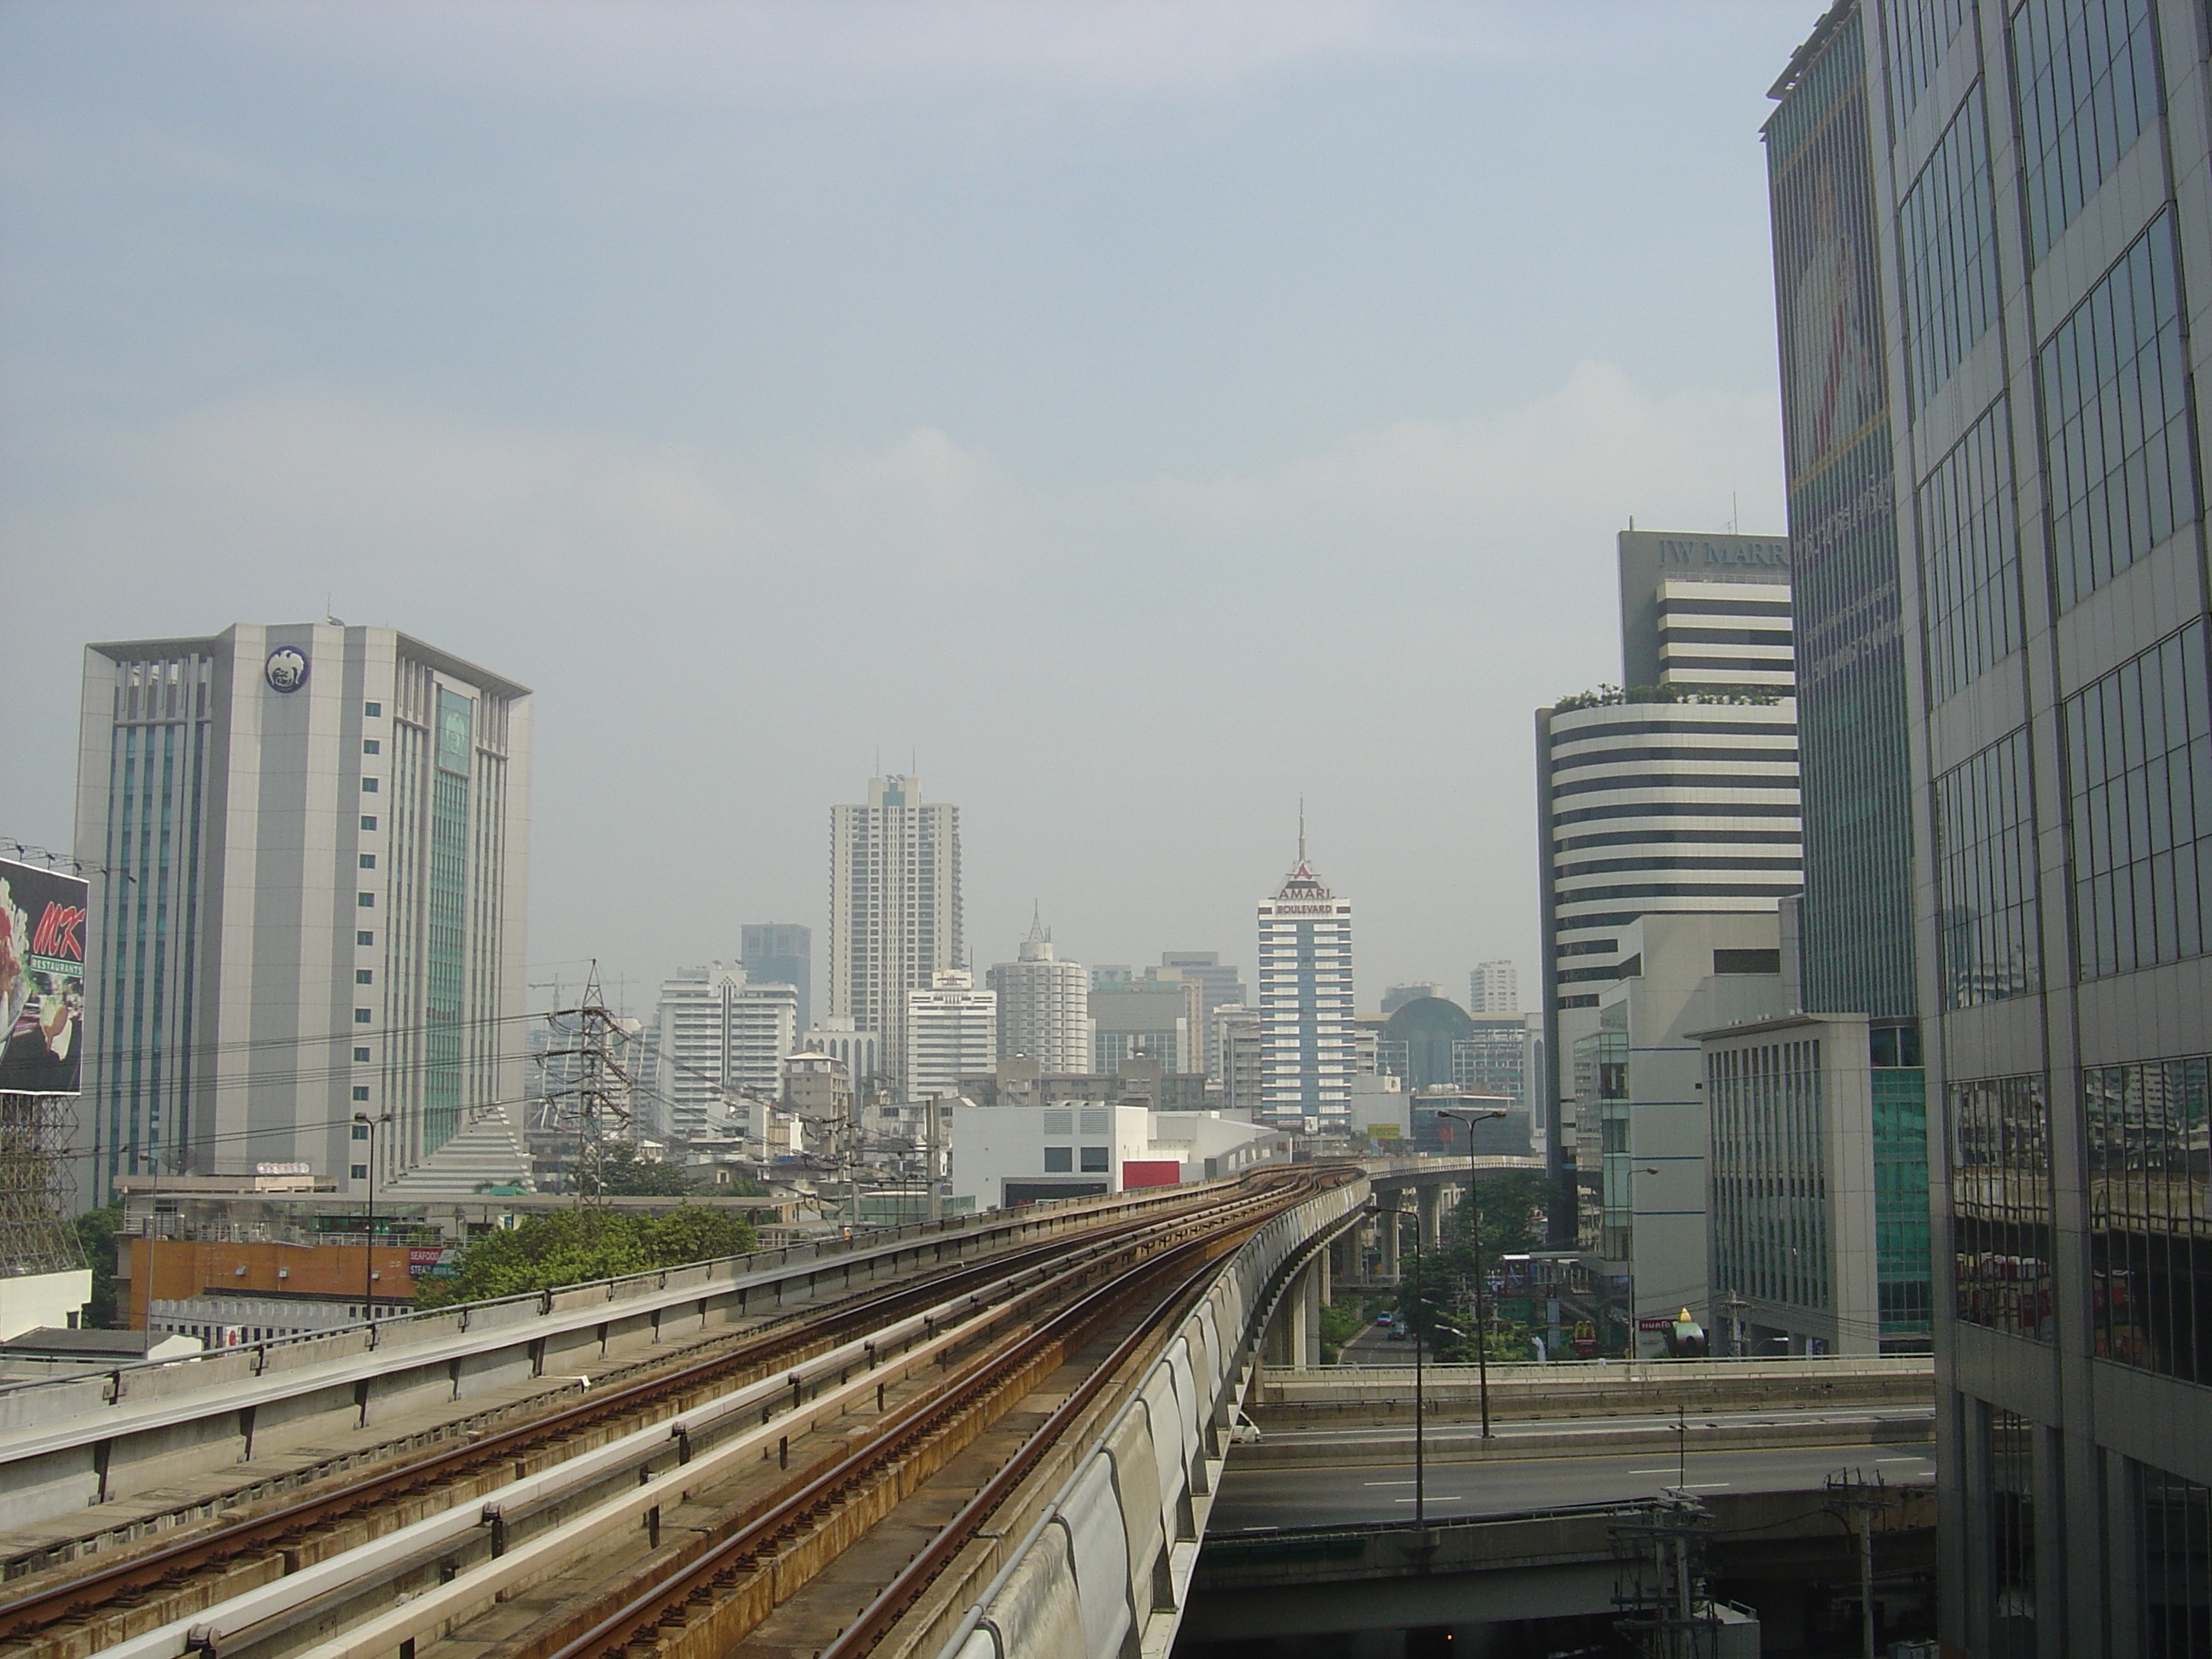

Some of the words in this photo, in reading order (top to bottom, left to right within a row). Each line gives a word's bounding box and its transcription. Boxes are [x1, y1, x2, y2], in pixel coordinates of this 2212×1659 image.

[1658, 538, 1696, 568] JW
[1279, 888, 1330, 900] AMARI
[1277, 905, 1332, 914] BOULEVARD
[33, 900, 86, 961] MK
[32, 959, 83, 975] RESTAURANTS
[410, 1251, 439, 1260] SEAFOOD
